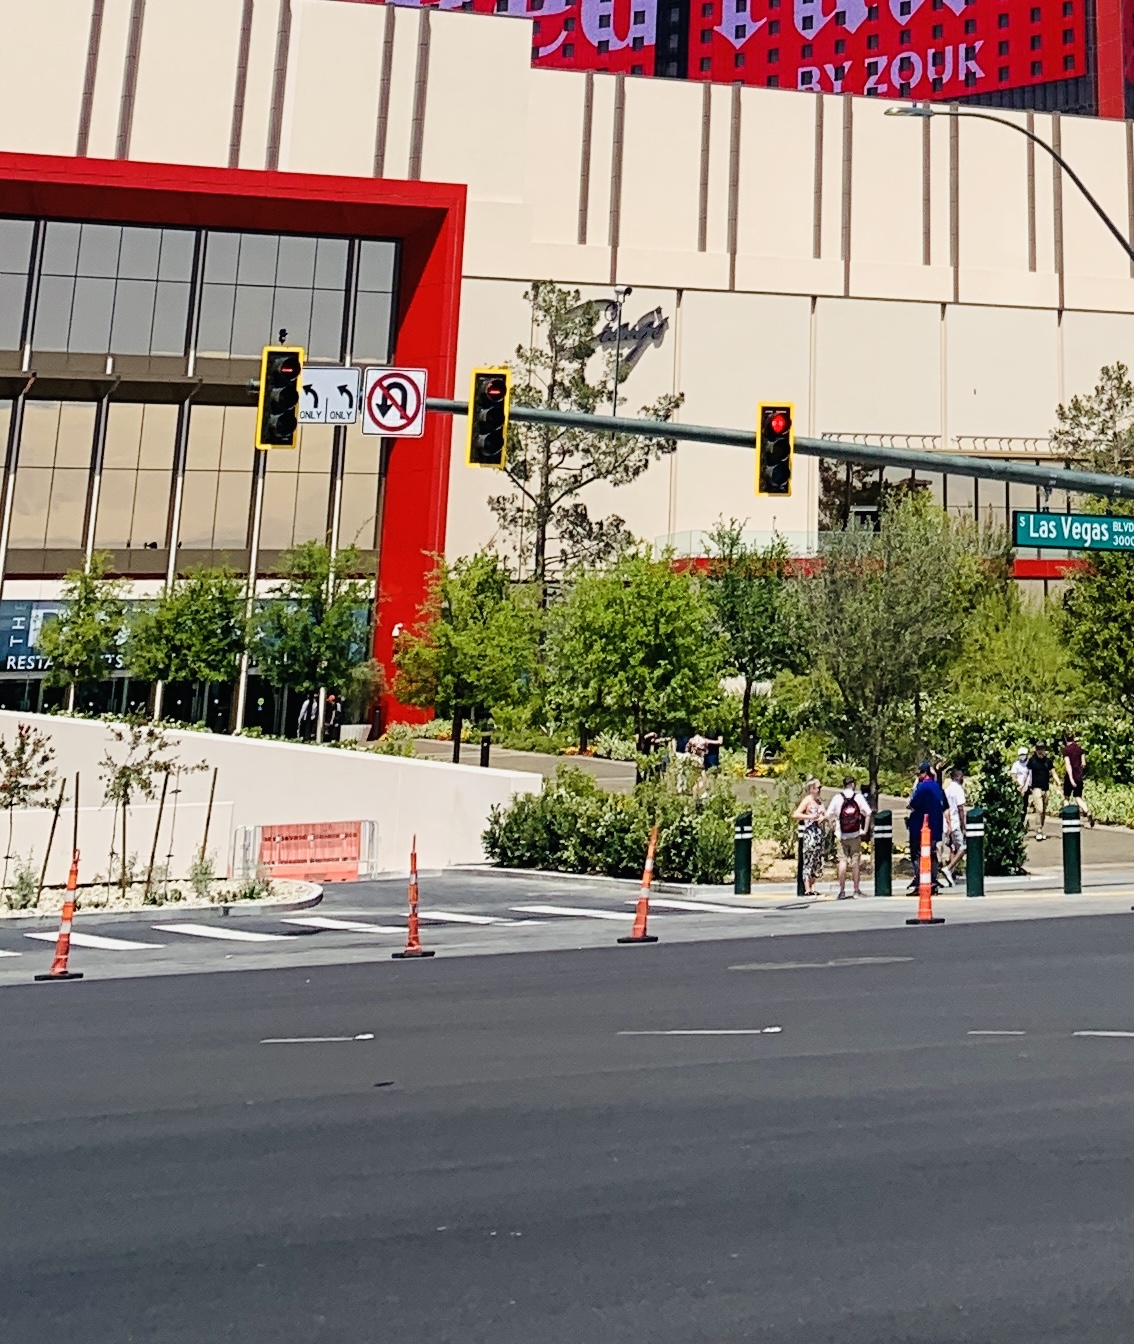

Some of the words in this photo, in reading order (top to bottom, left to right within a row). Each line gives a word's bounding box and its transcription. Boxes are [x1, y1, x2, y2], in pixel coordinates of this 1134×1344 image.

[798, 60, 853, 93] BY
[864, 40, 986, 96] ZOUK
[299, 410, 322, 420] ONLY
[330, 410, 352, 420] ONLY
[1019, 516, 1026, 528] S
[1029, 515, 1057, 539] Las
[1061, 516, 1109, 547] Vegas
[1112, 521, 1134, 533] BLVD
